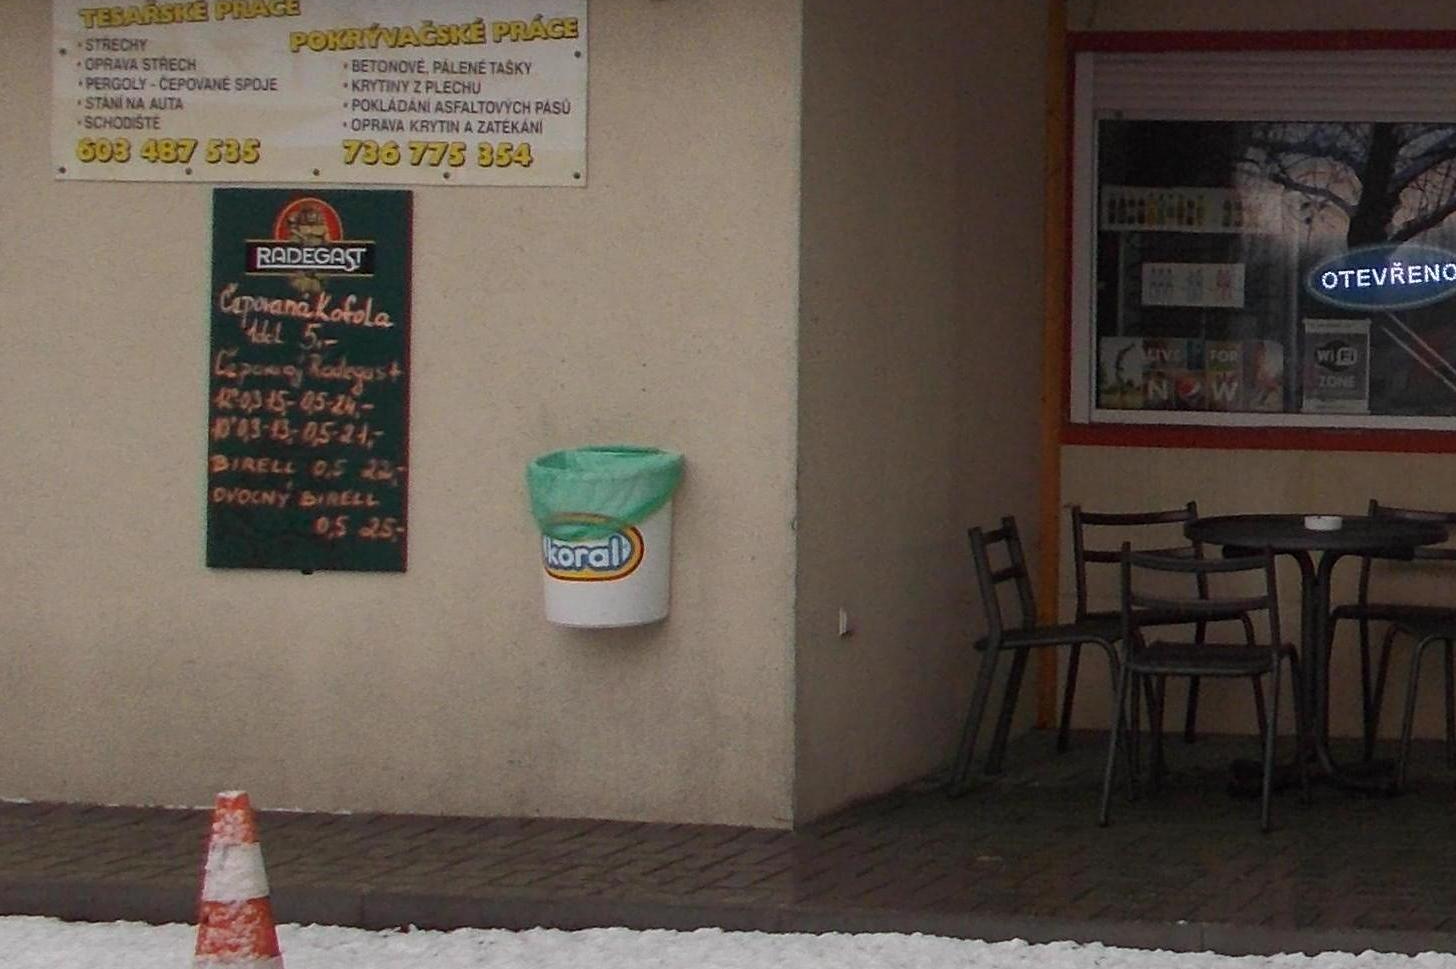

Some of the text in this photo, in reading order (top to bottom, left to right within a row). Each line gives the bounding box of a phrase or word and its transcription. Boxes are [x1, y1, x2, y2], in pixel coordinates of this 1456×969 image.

[288, 12, 579, 53] POKRÝVAČSKÉ PRÁCE
[84, 54, 197, 72] OPRAVA STŘECH
[433, 59, 488, 76] PÁLENÉ
[490, 60, 533, 77] TAŠKY
[85, 76, 147, 92] PERGOLY
[235, 77, 278, 92] SPOJE
[352, 79, 481, 95] KRYTINY Z PLECHU
[126, 96, 145, 111] NA
[149, 96, 184, 111] AUTA
[352, 97, 571, 116] POKLÁDÁNÍ ASFALTOVÝCH PÁSŮ
[351, 118, 544, 135] OPRAVA KRYTIN A ZATÉKÁNÍ
[76, 136, 261, 164] 603 487 535
[342, 139, 534, 168] 736 775 354
[256, 246, 367, 272] RADEGAST
[1209, 349, 1238, 363] FOR
[1319, 375, 1357, 389] ZONE
[208, 453, 297, 475] BIRELL
[546, 534, 620, 568] koral
